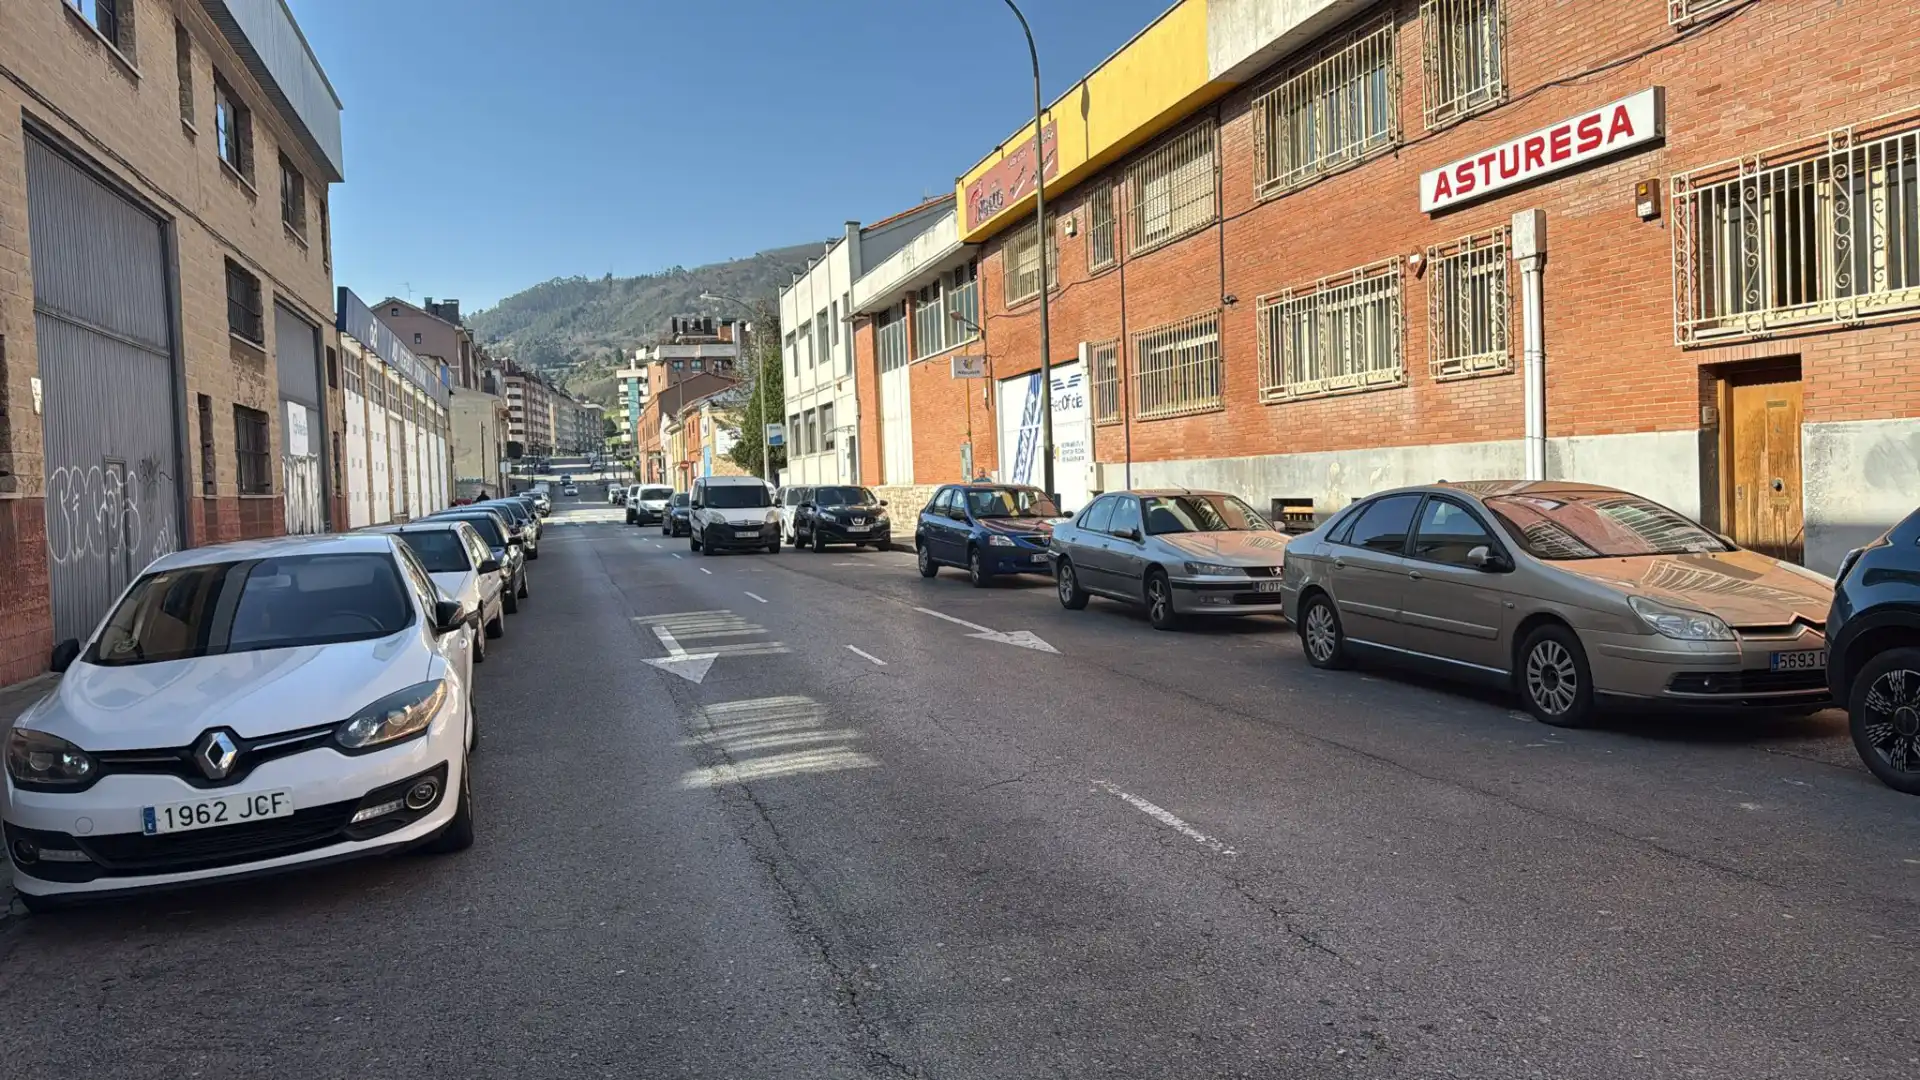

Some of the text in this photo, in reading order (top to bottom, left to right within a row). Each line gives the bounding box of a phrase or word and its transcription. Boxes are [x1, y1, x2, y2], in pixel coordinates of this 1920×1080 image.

[1433, 104, 1635, 203] ASTURESA
[1780, 652, 1815, 668] 5693
[164, 801, 229, 829] 1962
[239, 792, 285, 819] JCF
